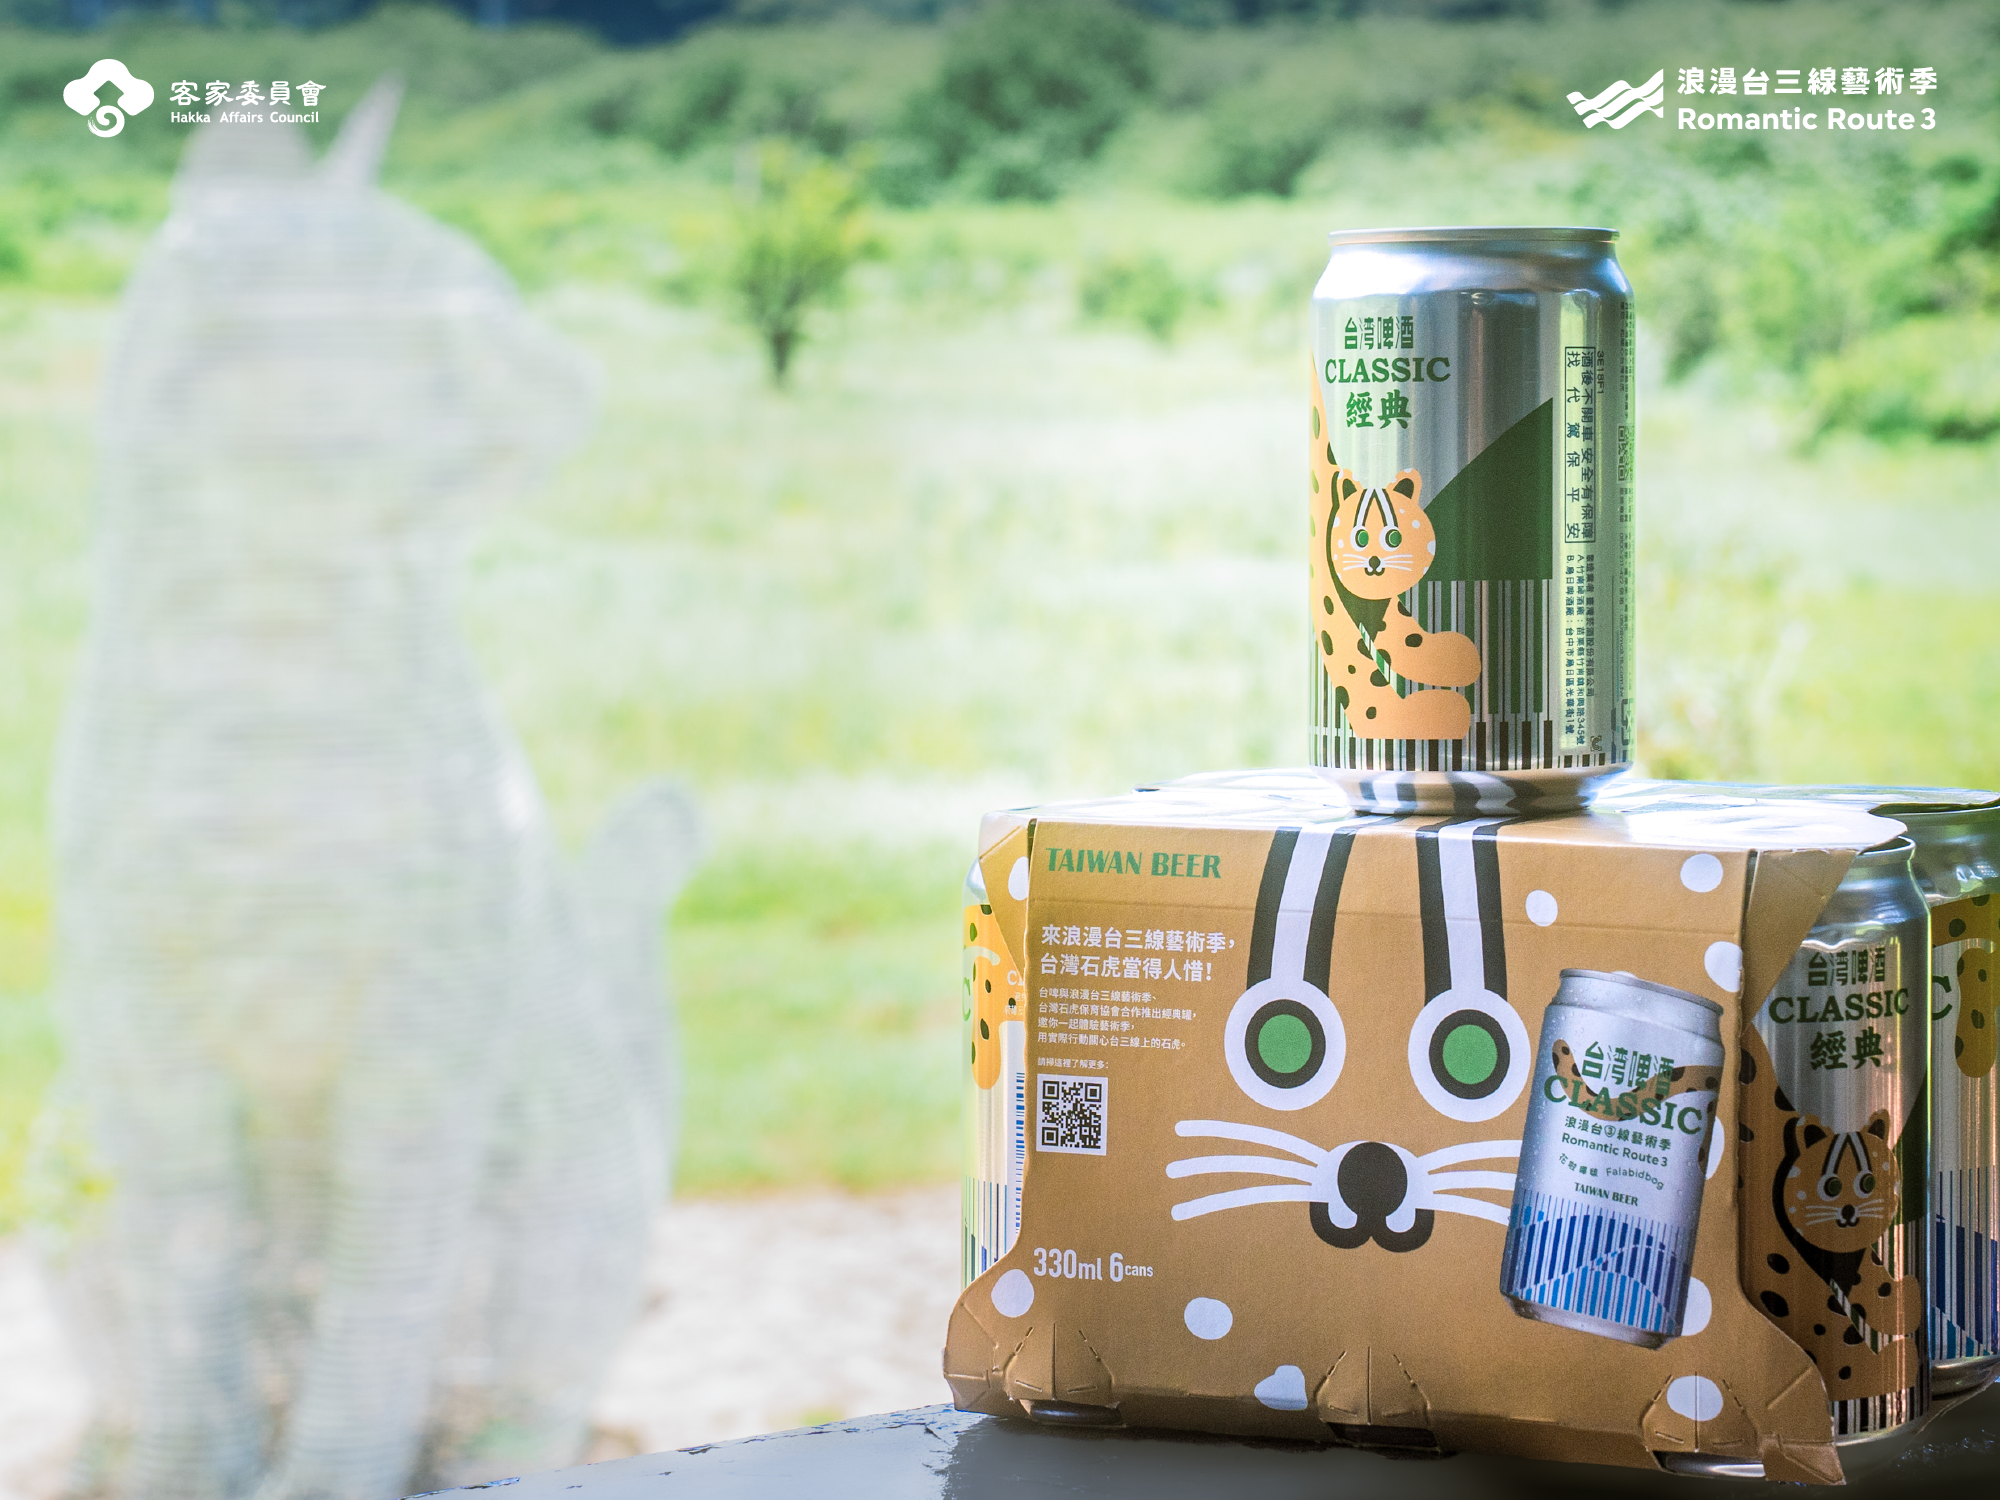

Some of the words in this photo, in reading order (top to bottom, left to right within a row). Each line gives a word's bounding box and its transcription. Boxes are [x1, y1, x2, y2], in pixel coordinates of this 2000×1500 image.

[1325, 357, 1451, 384] CLASSIC
[1346, 389, 1412, 430] 經典
[1046, 847, 1142, 875] TAIWAN
[1151, 851, 1222, 879] BEER
[1768, 988, 1909, 1024] CLASSIC
[1810, 1026, 1884, 1071] 經典
[1544, 1075, 1703, 1135] CLASSIC
[1562, 1132, 1619, 1156] Romantic
[1574, 1182, 1610, 1200] TAIWAN
[1611, 1192, 1639, 1207] BEER
[1606, 1166, 1665, 1191] Falabidbog
[1033, 1247, 1103, 1281] 330ml
